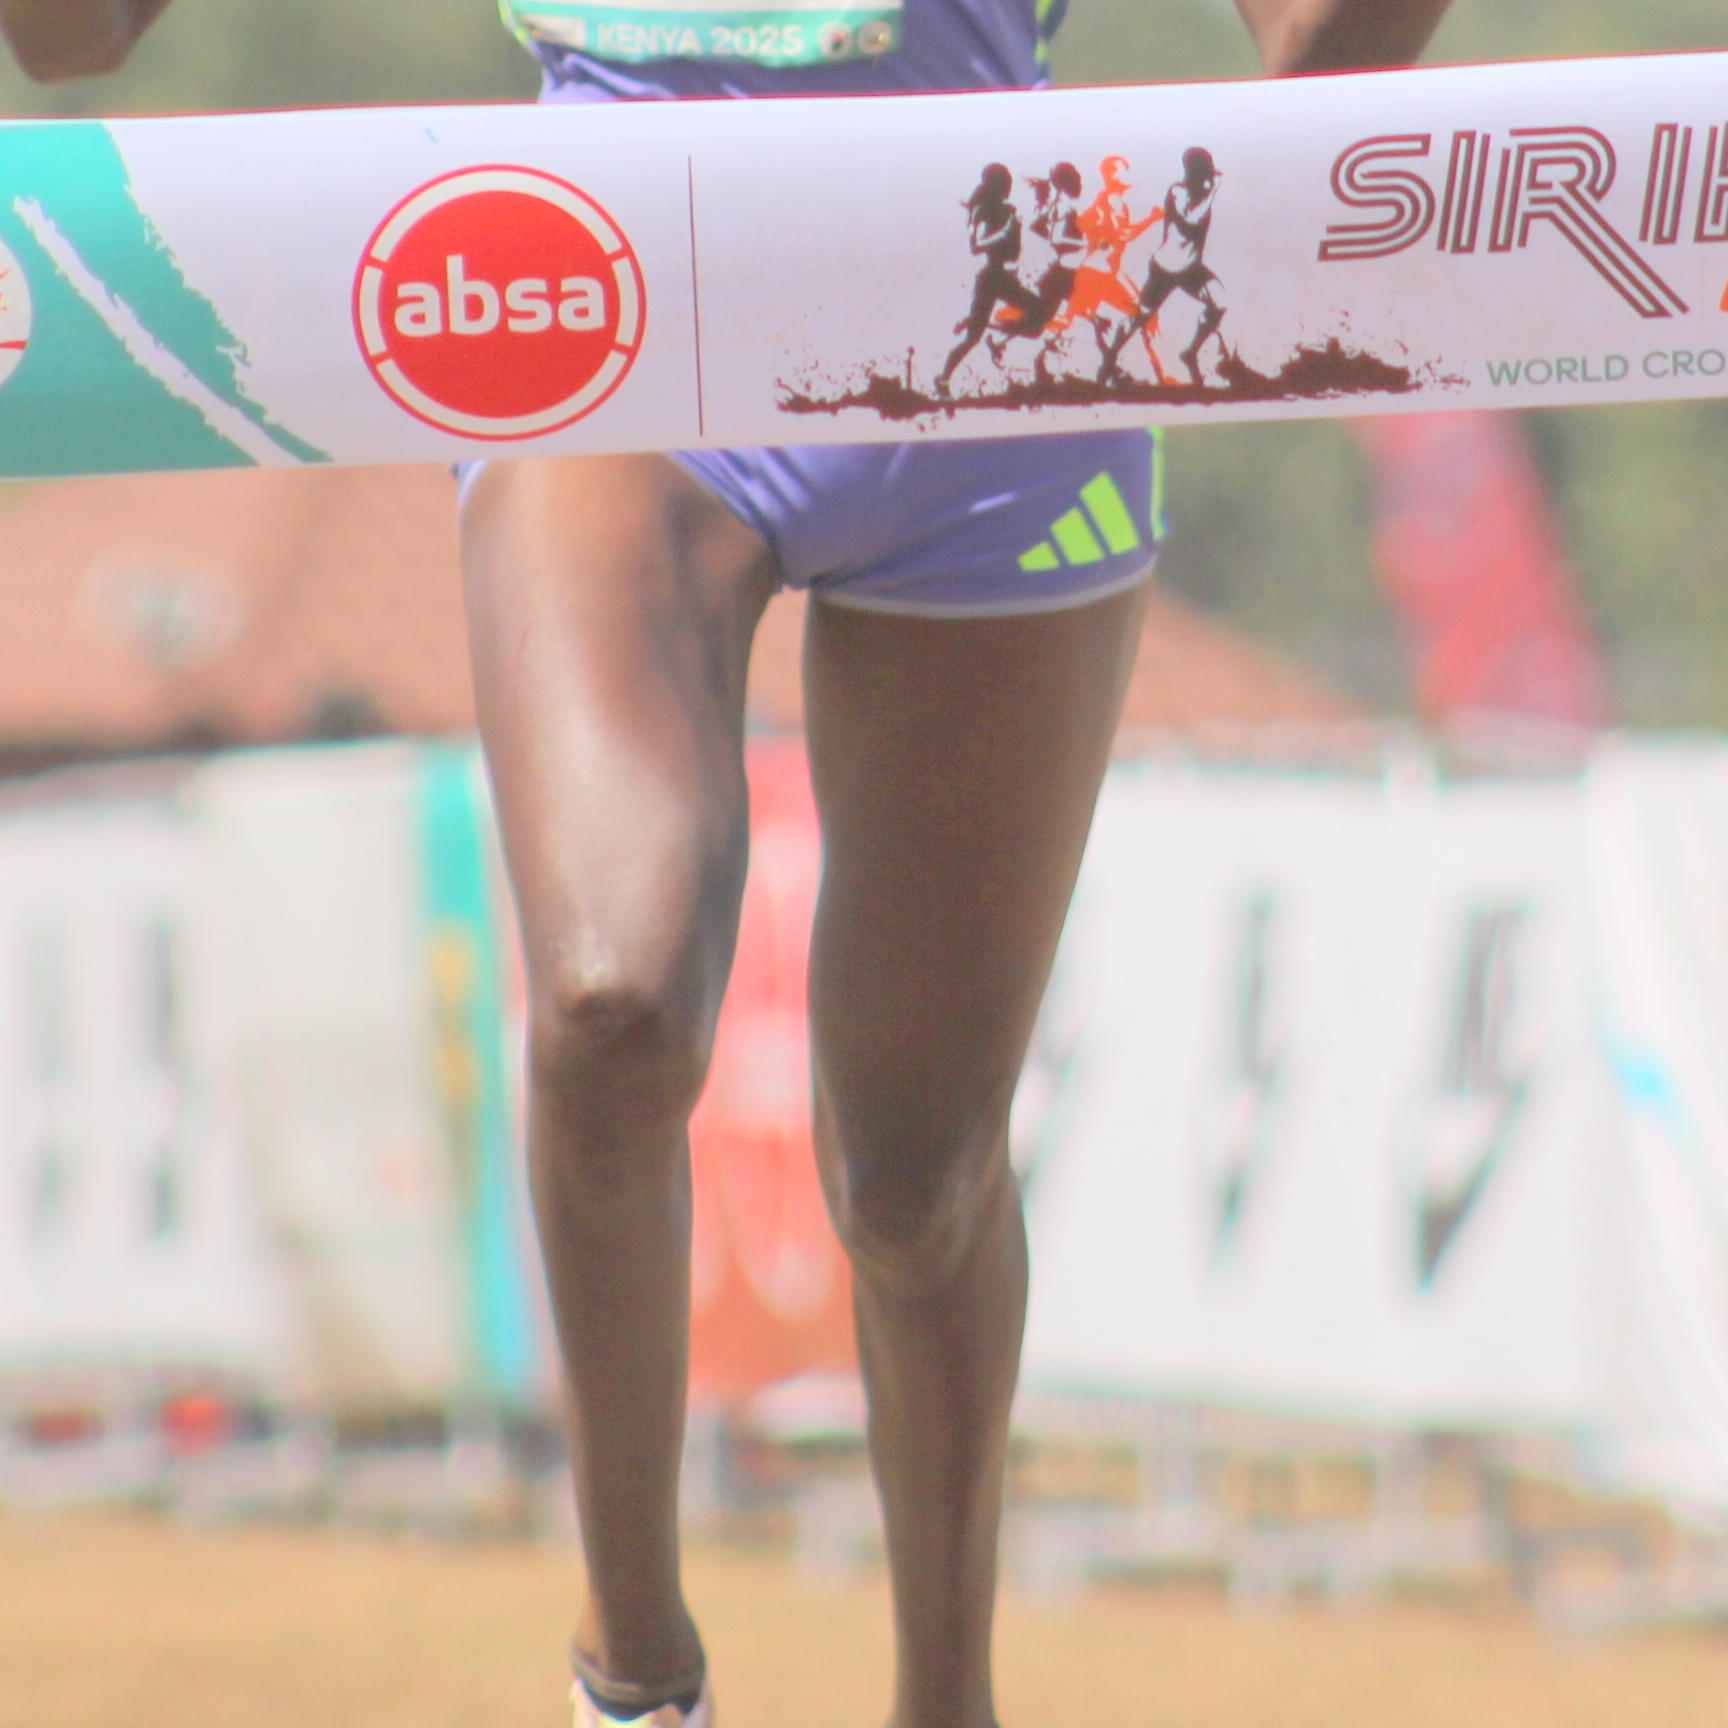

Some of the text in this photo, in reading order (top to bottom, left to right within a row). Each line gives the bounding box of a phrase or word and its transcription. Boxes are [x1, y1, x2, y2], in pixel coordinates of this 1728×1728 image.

[597, 22, 805, 57] KENYA 2025
[393, 254, 606, 337] absa
[1485, 354, 1629, 387] WORLD
